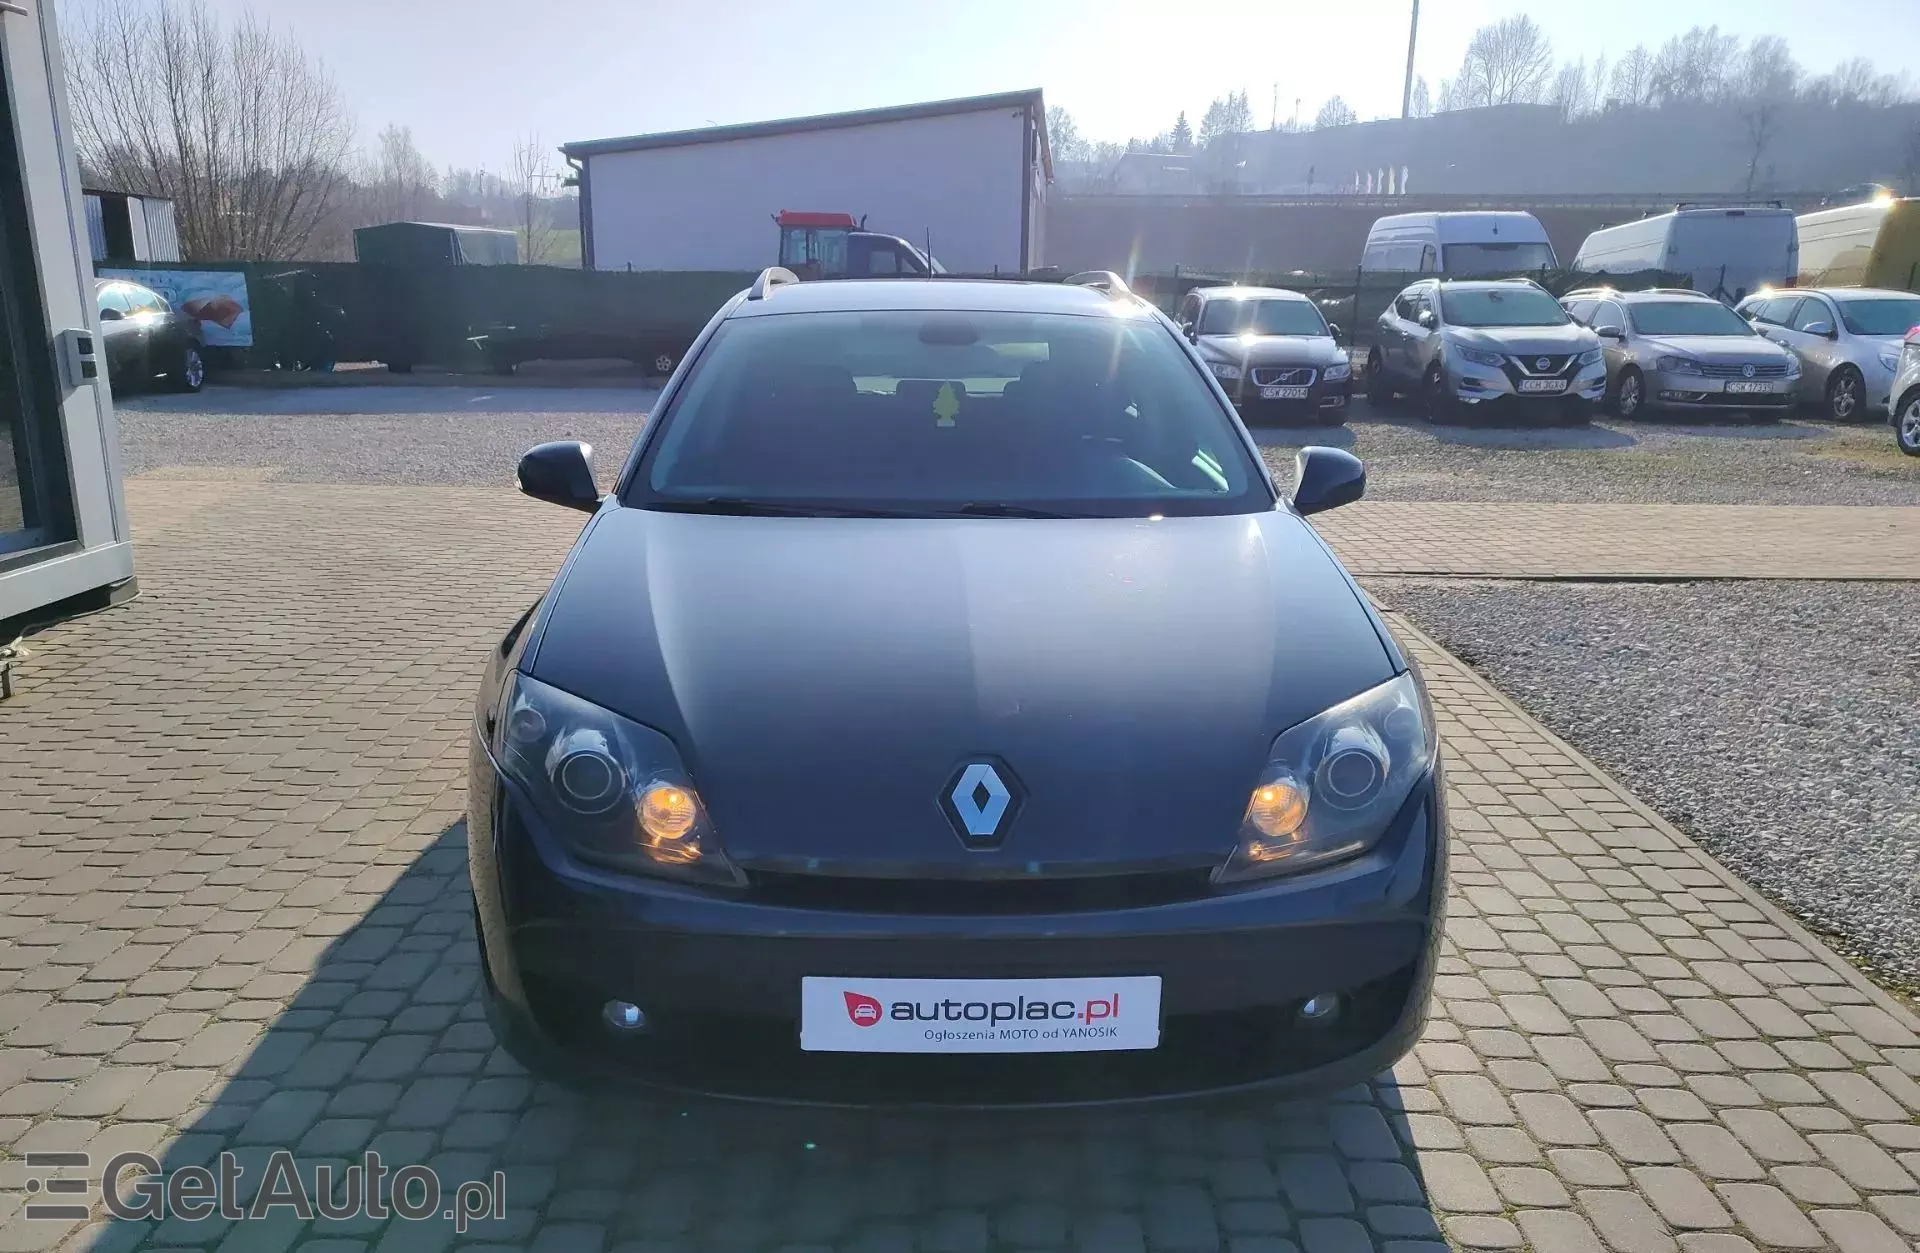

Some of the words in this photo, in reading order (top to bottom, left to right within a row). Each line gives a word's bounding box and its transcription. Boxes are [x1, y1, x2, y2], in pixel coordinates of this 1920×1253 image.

[890, 993, 1119, 1027] autoplac.pl
[924, 1029, 996, 1043] Ogłoszenia
[1000, 1029, 1039, 1040] MOTO
[1042, 1028, 1059, 1040] od
[1062, 1026, 1118, 1039] YANOSIK
